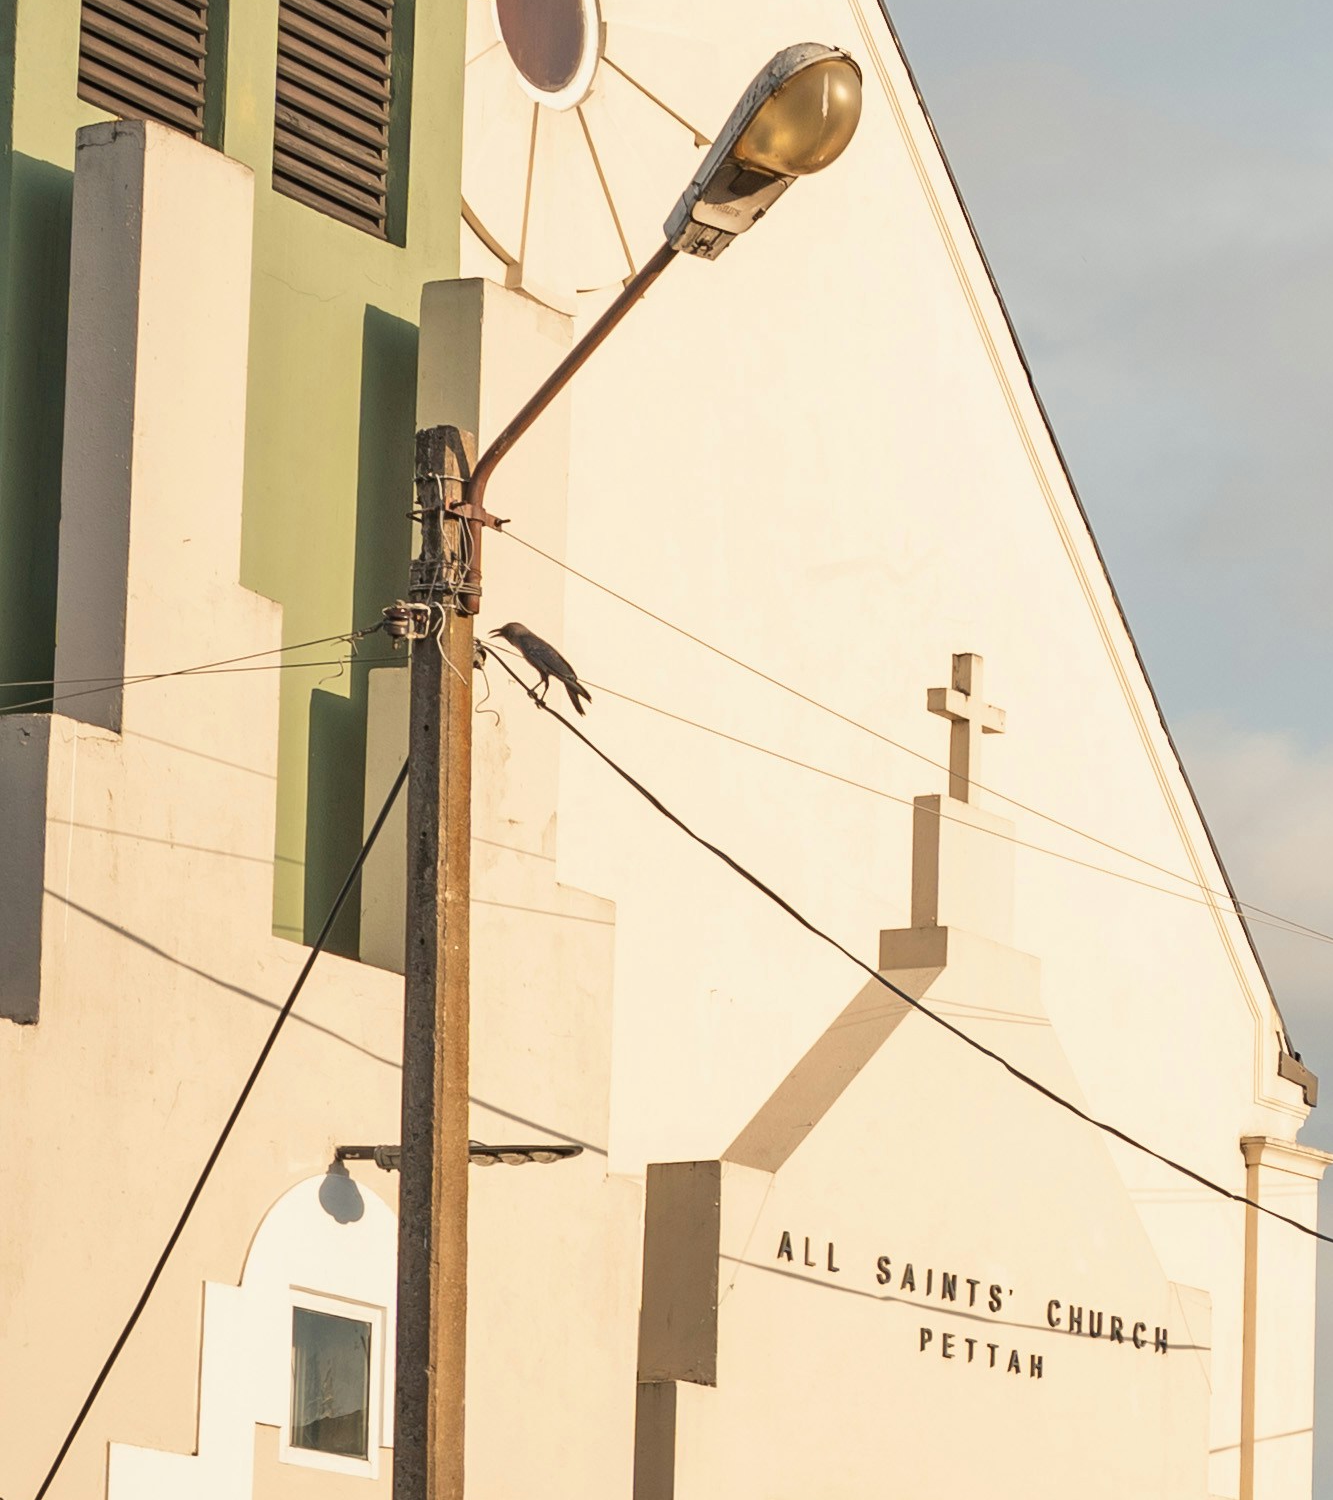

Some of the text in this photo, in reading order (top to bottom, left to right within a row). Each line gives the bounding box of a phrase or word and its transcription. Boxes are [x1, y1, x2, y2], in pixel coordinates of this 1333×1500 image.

[777, 1229, 841, 1274] ALL
[1046, 1299, 1169, 1355] CHURCH
[919, 1326, 1045, 1380] PETTAH
